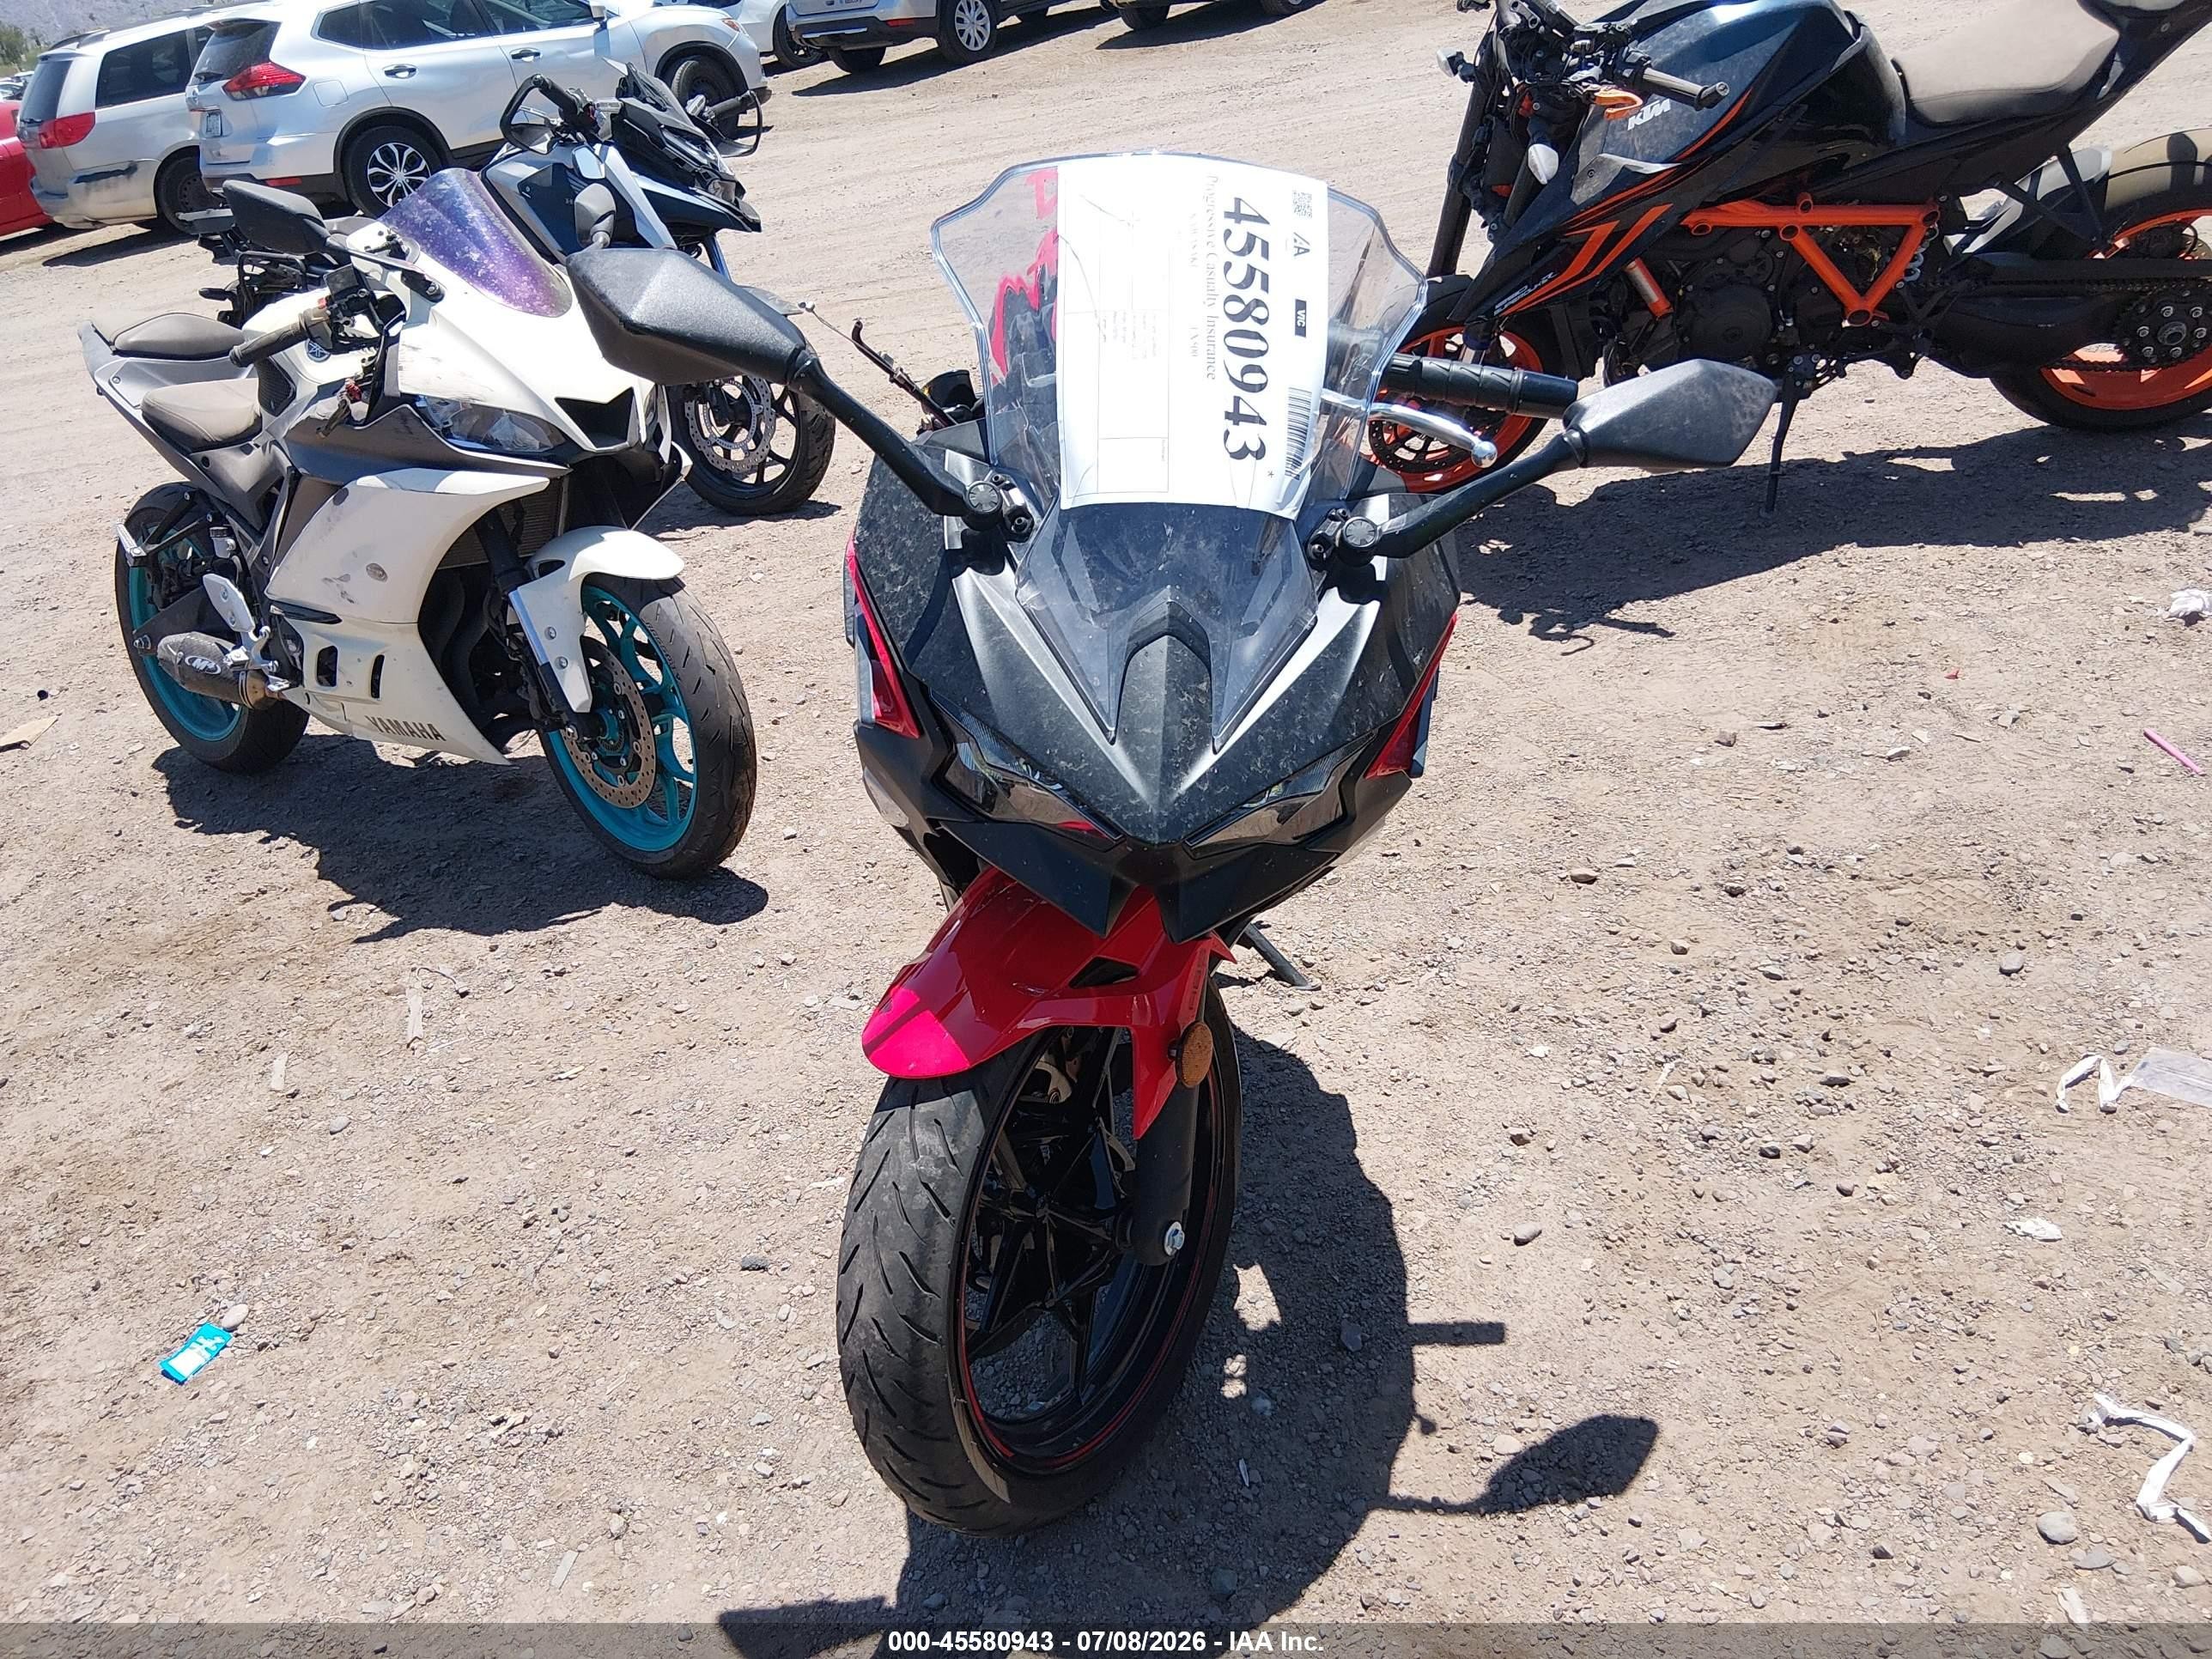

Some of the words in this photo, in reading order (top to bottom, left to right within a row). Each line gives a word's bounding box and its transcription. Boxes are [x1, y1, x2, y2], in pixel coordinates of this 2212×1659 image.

[1627, 98, 1671, 131] KTM
[1203, 174, 1218, 249] Progressive
[1204, 252, 1218, 308] Casualty
[1223, 197, 1269, 460] 45580943
[1296, 310, 1305, 327] VIC
[1206, 315, 1218, 380] Insurance
[364, 714, 447, 741] YAMAHA
